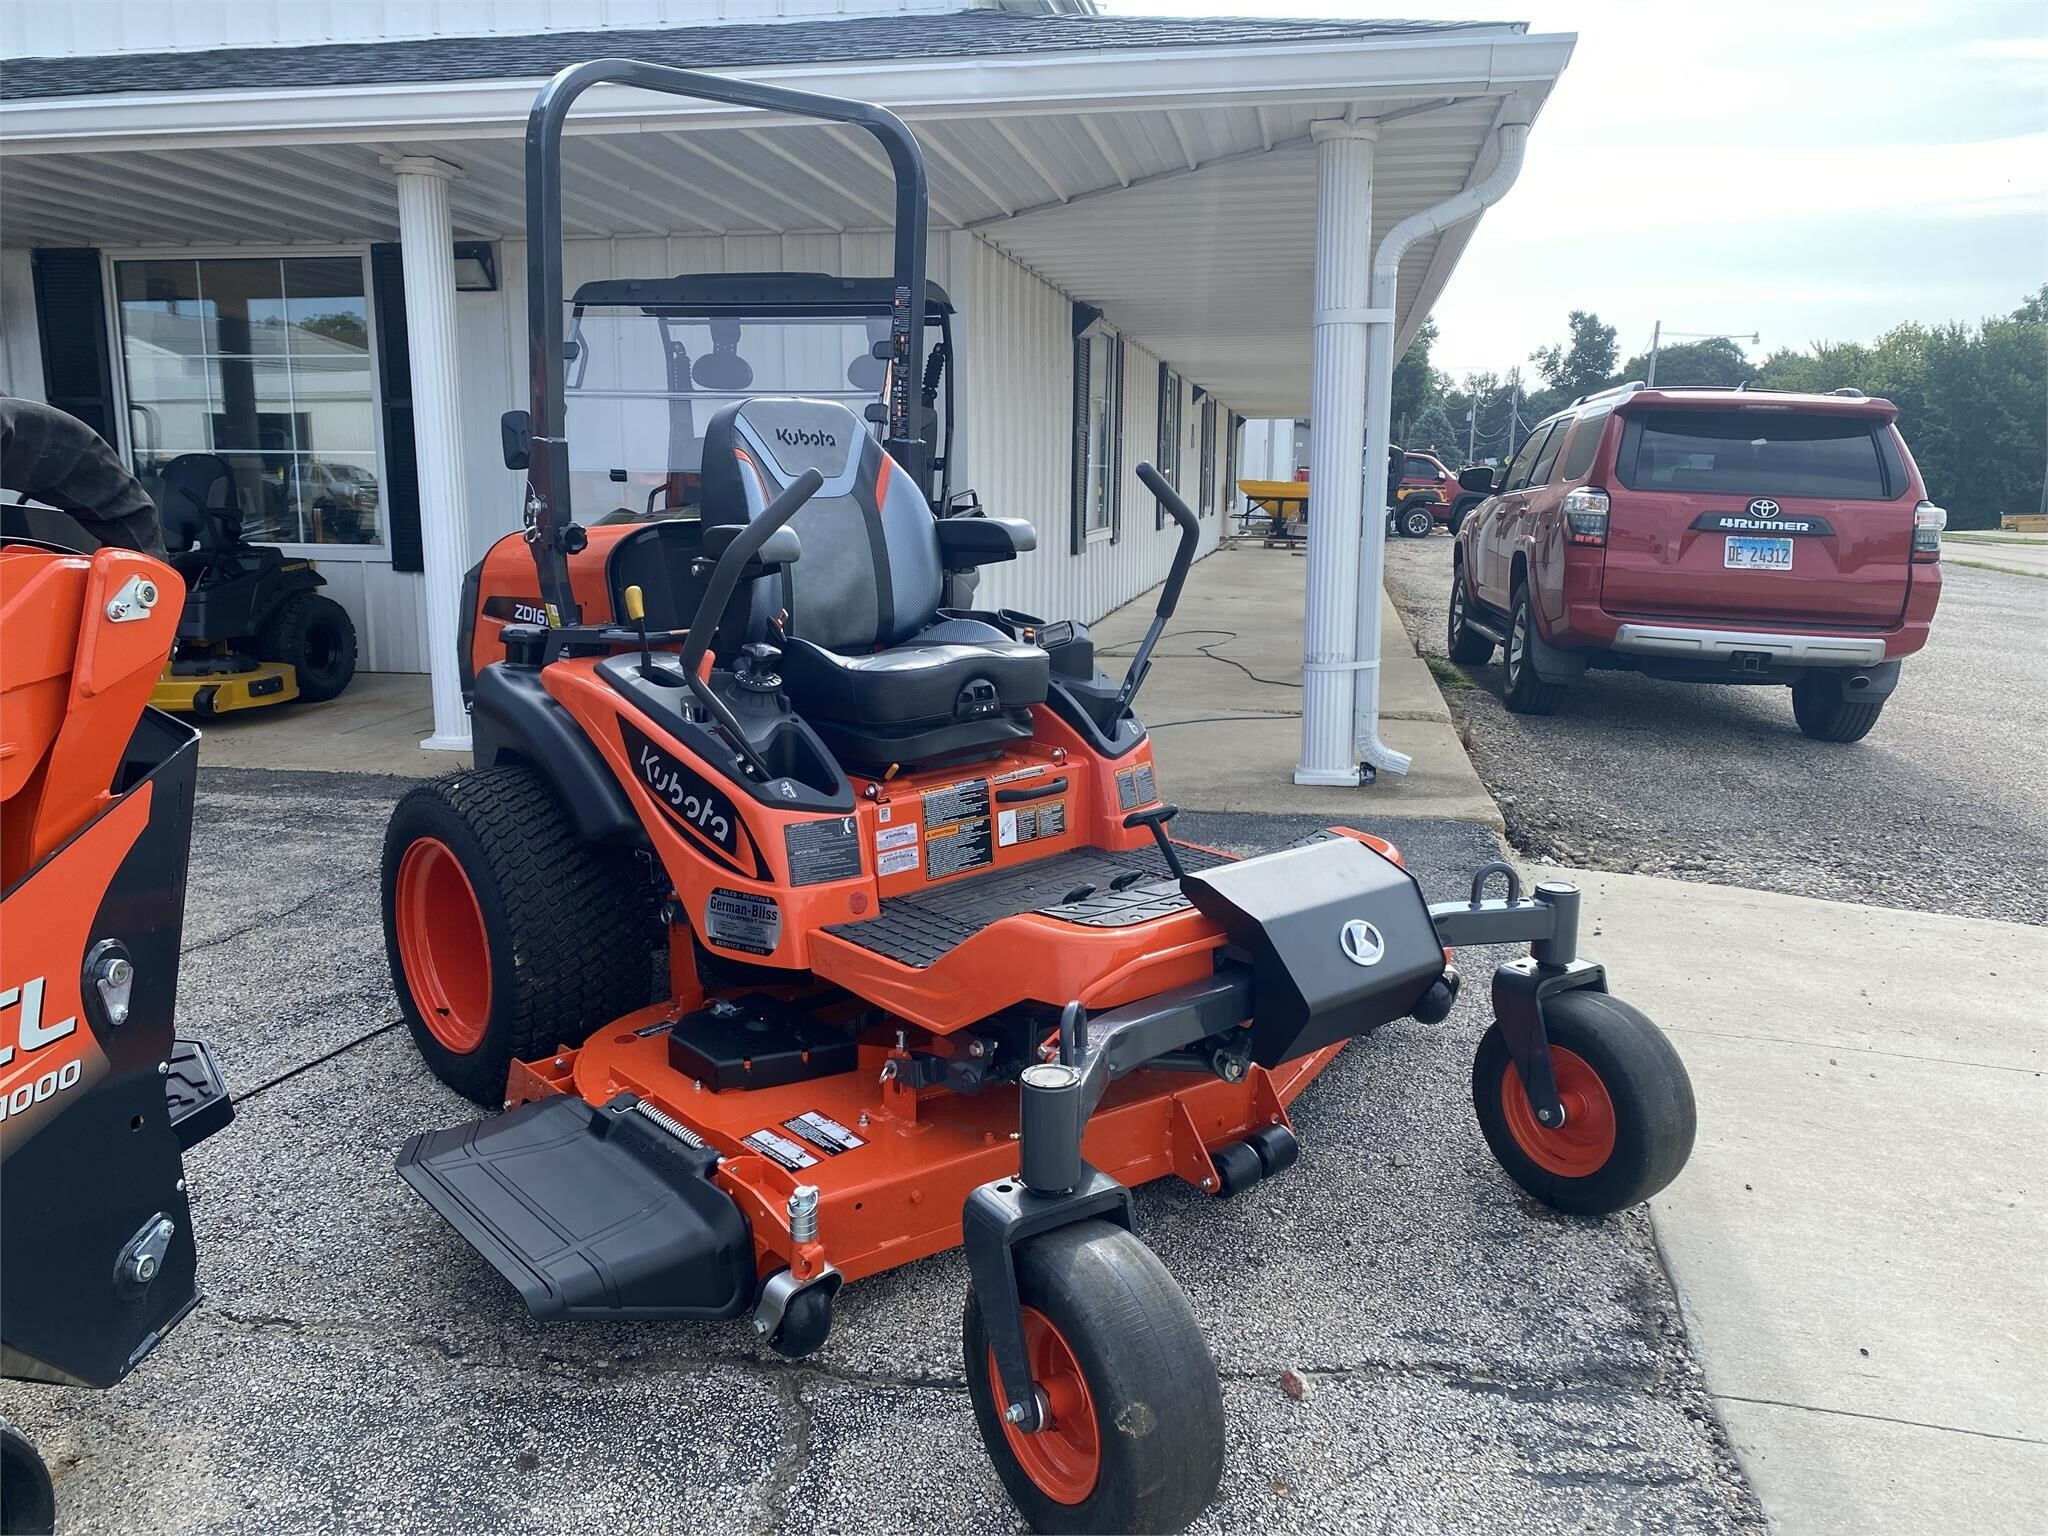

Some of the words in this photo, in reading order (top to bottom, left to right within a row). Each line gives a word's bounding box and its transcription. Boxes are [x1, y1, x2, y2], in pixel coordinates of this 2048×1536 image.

[775, 428, 837, 447] Kubota
[1719, 517, 1809, 532] 4RUNNER
[1728, 545, 1743, 562] DE
[1750, 546, 1789, 564] 24312
[640, 745, 729, 842] Kubota
[710, 896, 778, 921] German-Bliss
